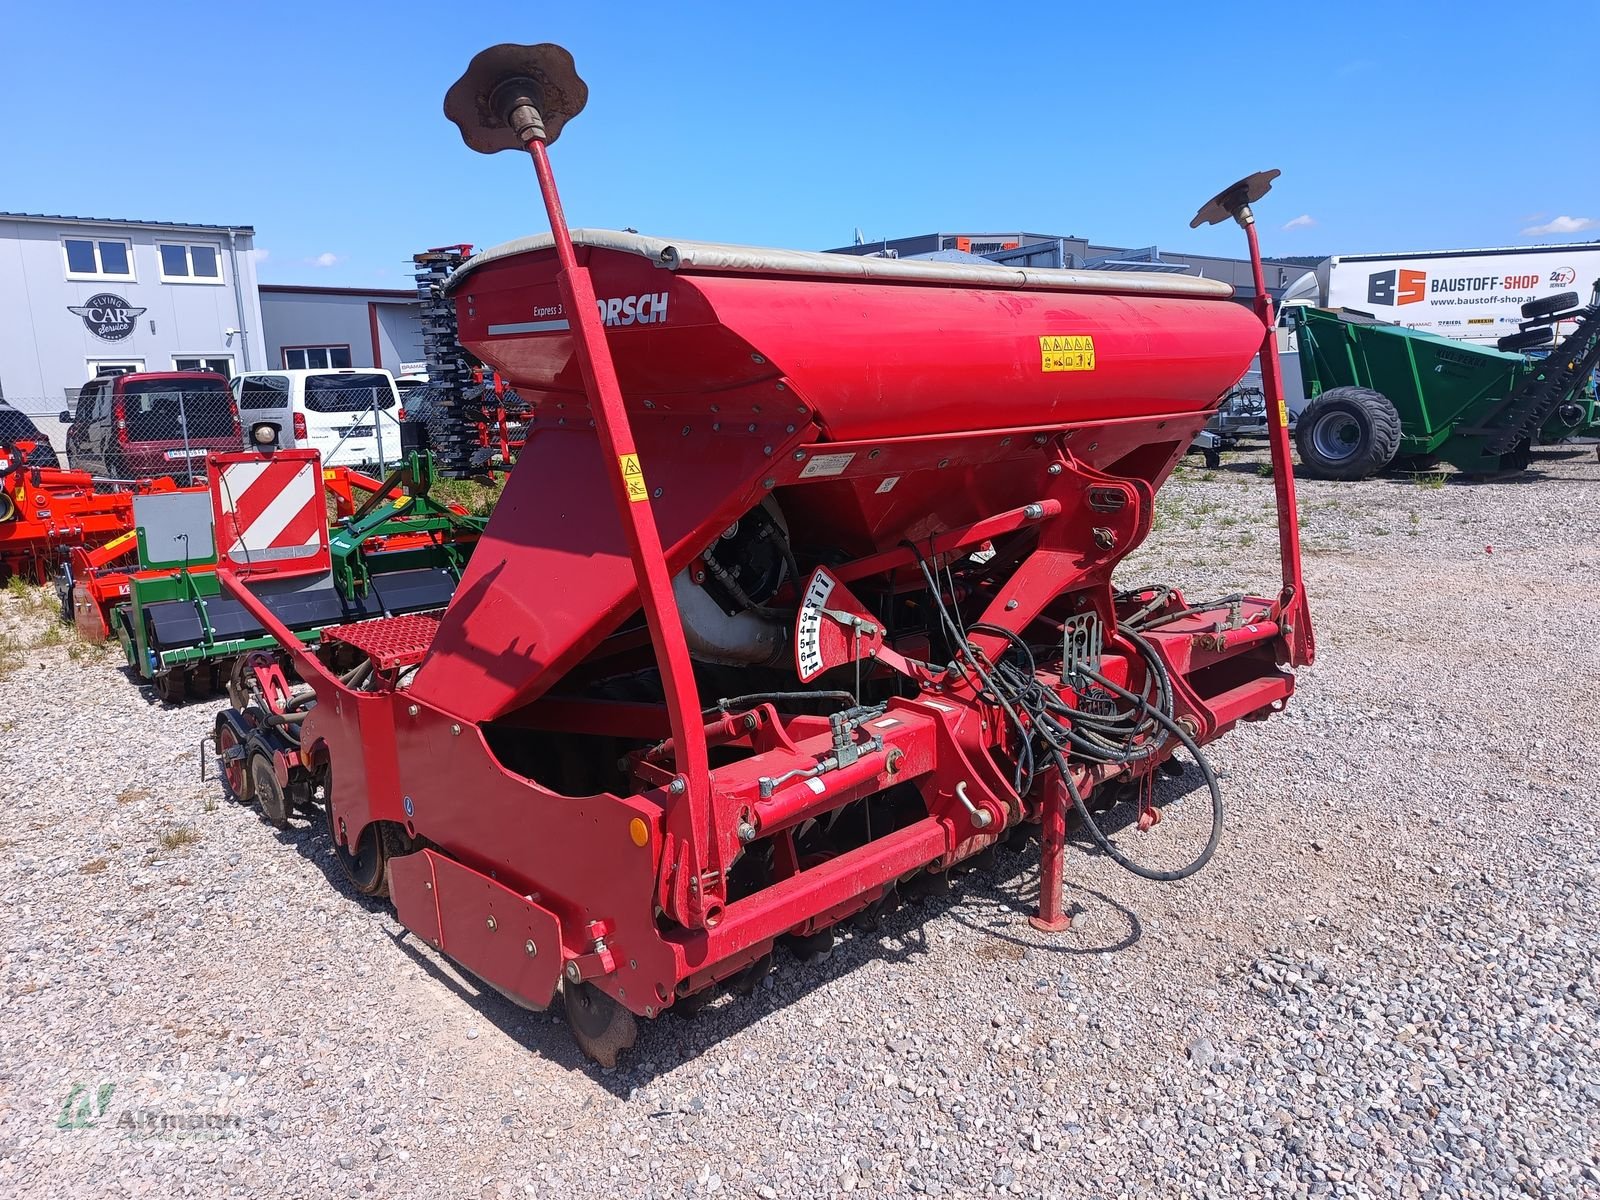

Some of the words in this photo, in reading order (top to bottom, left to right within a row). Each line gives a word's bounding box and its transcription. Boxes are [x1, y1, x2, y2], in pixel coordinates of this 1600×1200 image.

[1368, 269, 1426, 306] BS
[1431, 276, 1539, 292] BAUSTOFF-SHOP
[93, 297, 123, 308] FLYING
[1430, 296, 1536, 306] www.baustoff-shop.at
[533, 306, 557, 317] Express
[557, 304, 563, 314] 3
[596, 292, 668, 327] ORSCH
[88, 308, 131, 323] CAR
[98, 323, 129, 335] Service
[815, 573, 822, 582] 0
[811, 585, 816, 594] 1
[805, 598, 812, 608] 2
[802, 613, 808, 622] 3
[800, 625, 805, 634] 4
[800, 639, 806, 649] 5
[800, 651, 806, 662] 6
[803, 665, 808, 676] 7
